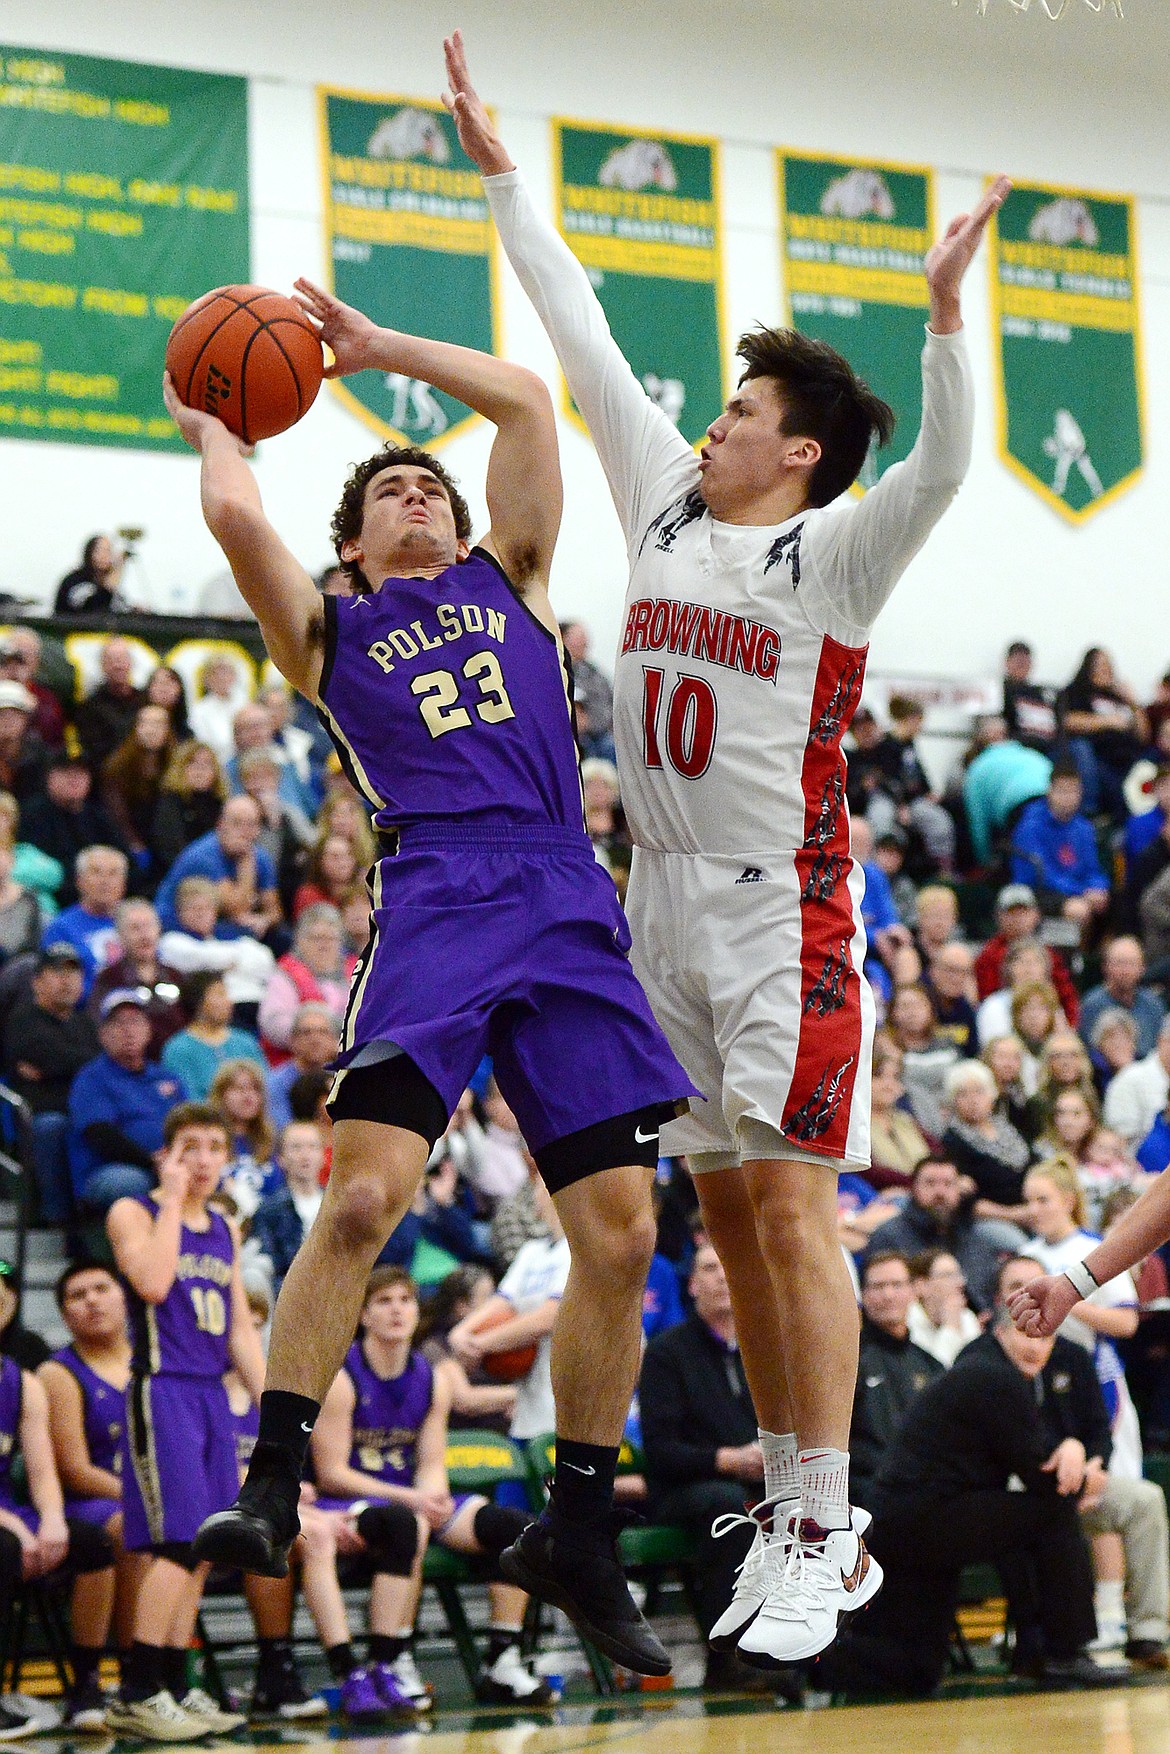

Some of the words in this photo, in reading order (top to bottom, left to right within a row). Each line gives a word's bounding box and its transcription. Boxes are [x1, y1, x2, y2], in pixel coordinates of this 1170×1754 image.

[367, 604, 507, 674] POLSON
[621, 599, 781, 685] BROWNING
[410, 649, 516, 739] 23
[643, 666, 718, 780] 10
[190, 1286, 226, 1337] 10
